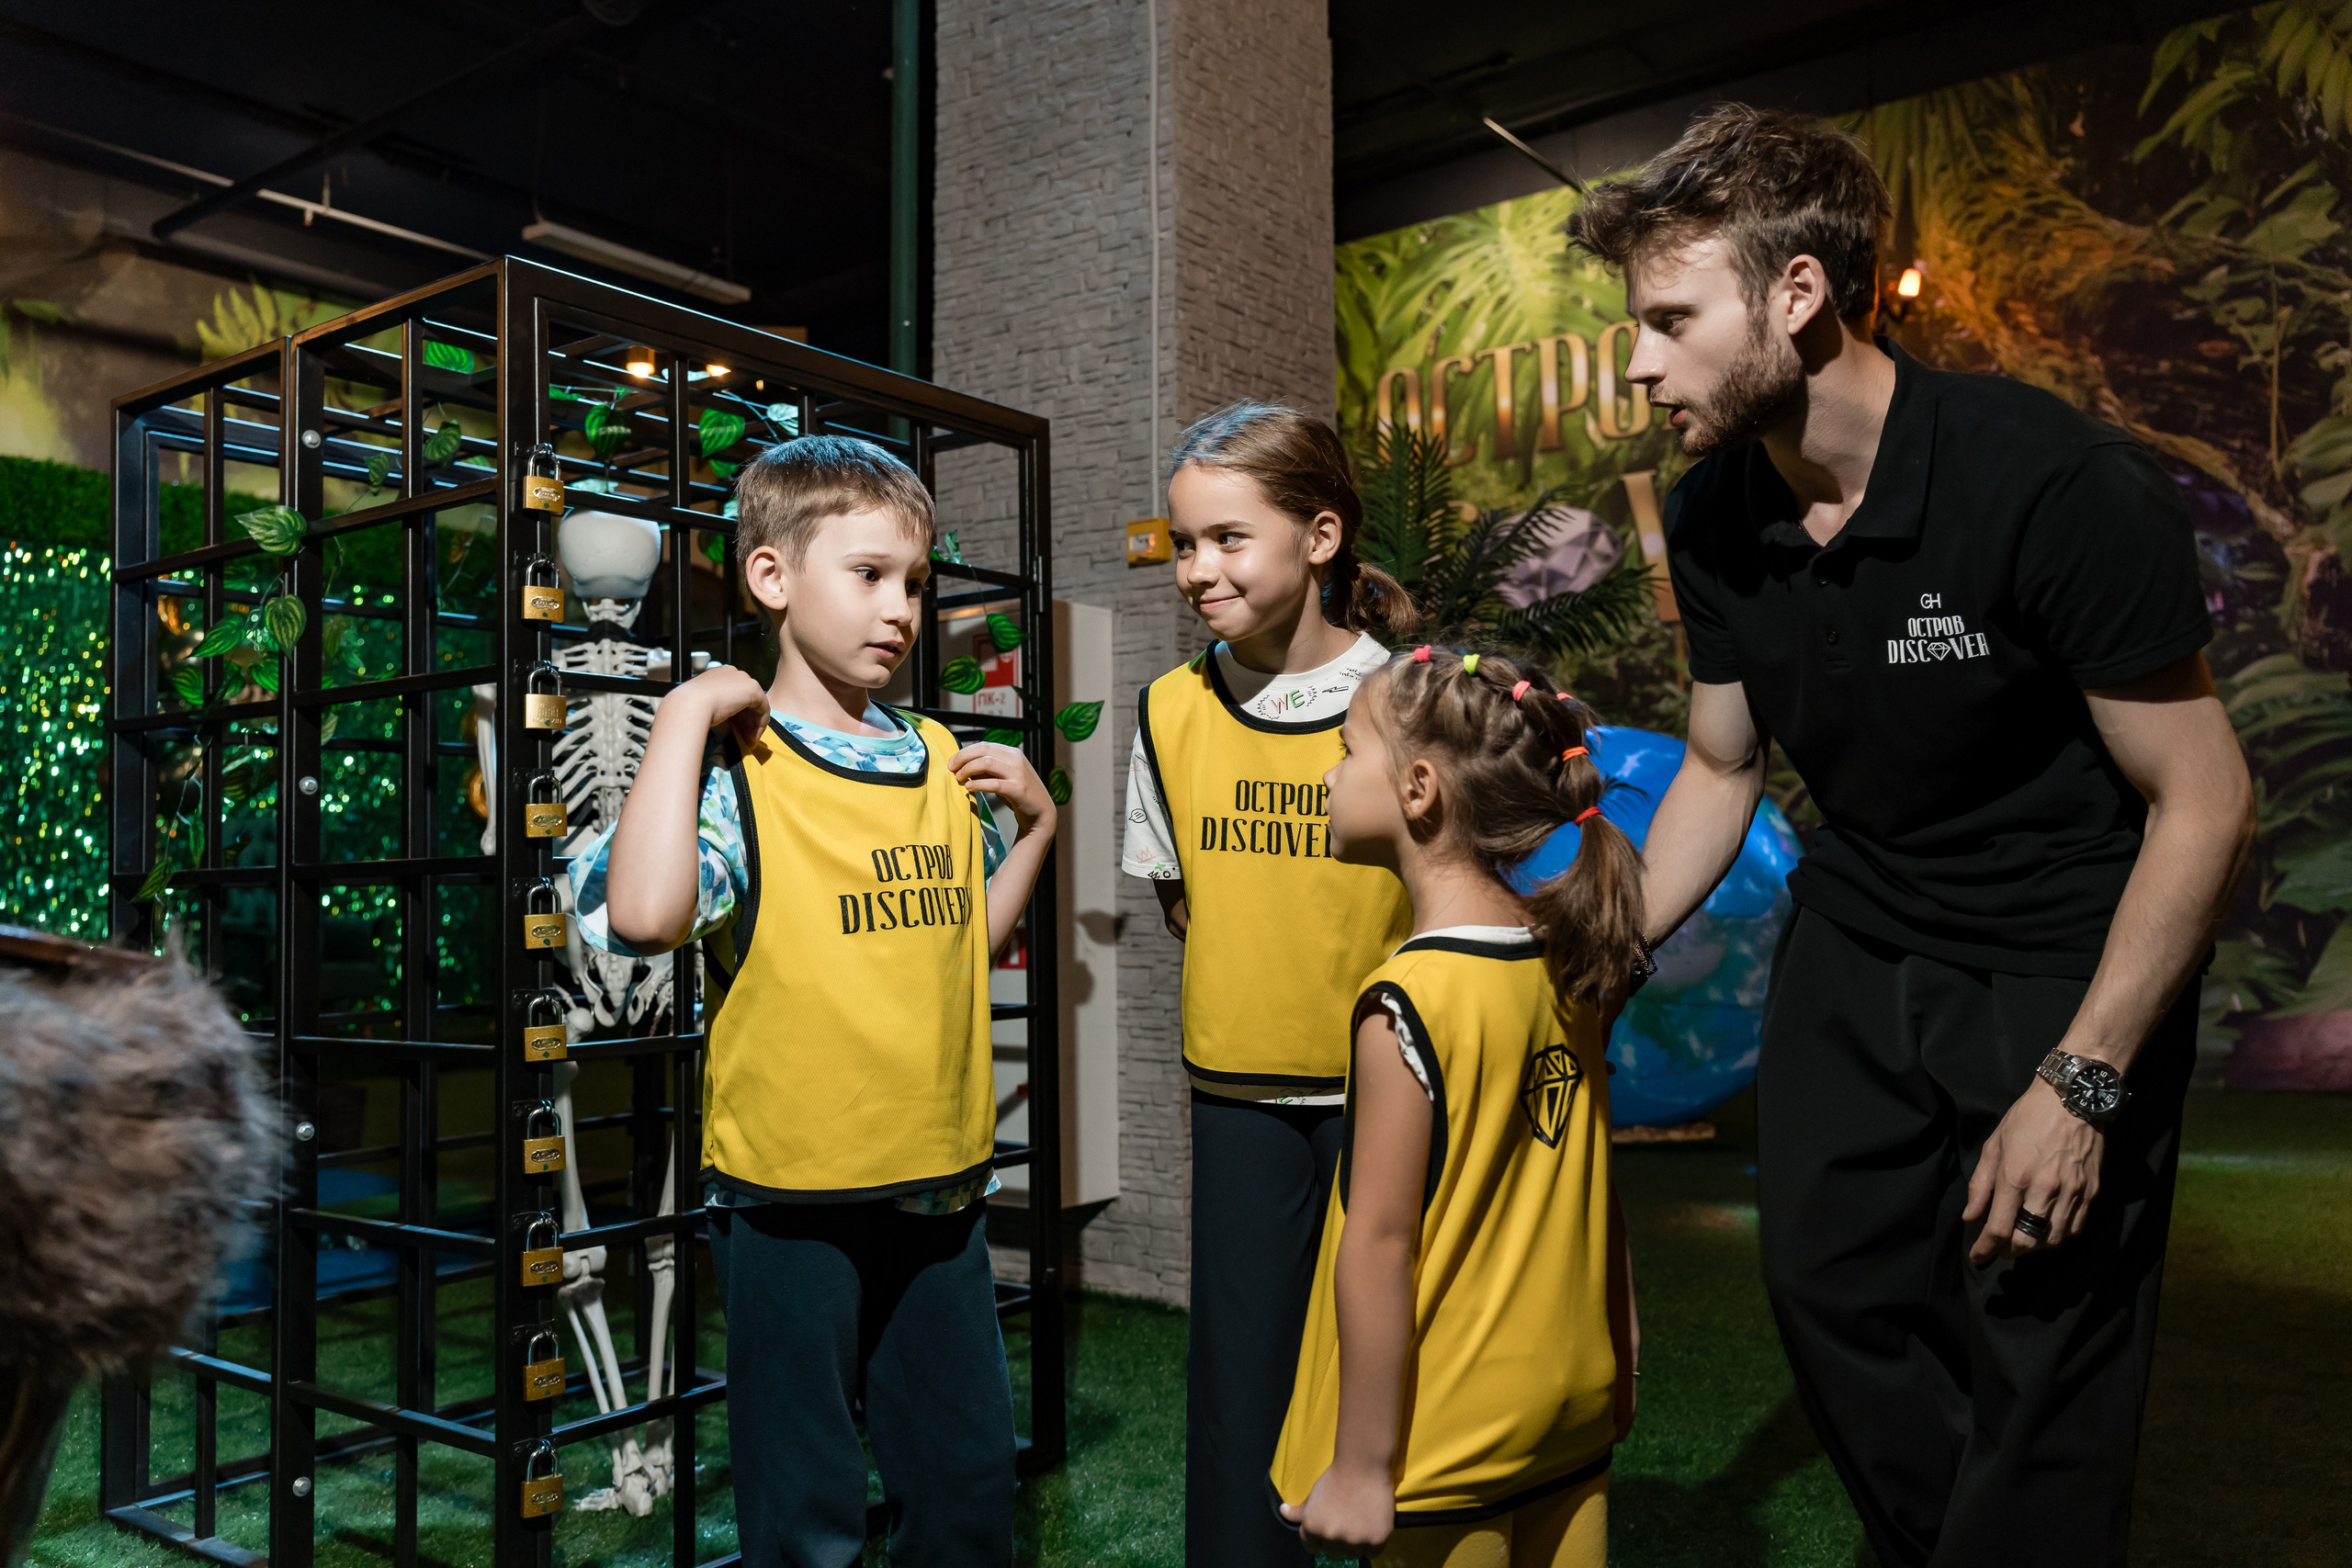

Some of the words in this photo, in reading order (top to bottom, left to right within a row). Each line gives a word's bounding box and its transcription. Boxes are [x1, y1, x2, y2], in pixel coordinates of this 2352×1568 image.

[1378, 321, 1674, 468] ОСТРО
[1920, 592, 1941, 609] GH
[1907, 615, 1965, 637] ОСТРОВ
[1270, 690, 1306, 715] WE
[871, 844, 954, 883] ОСТРОВ
